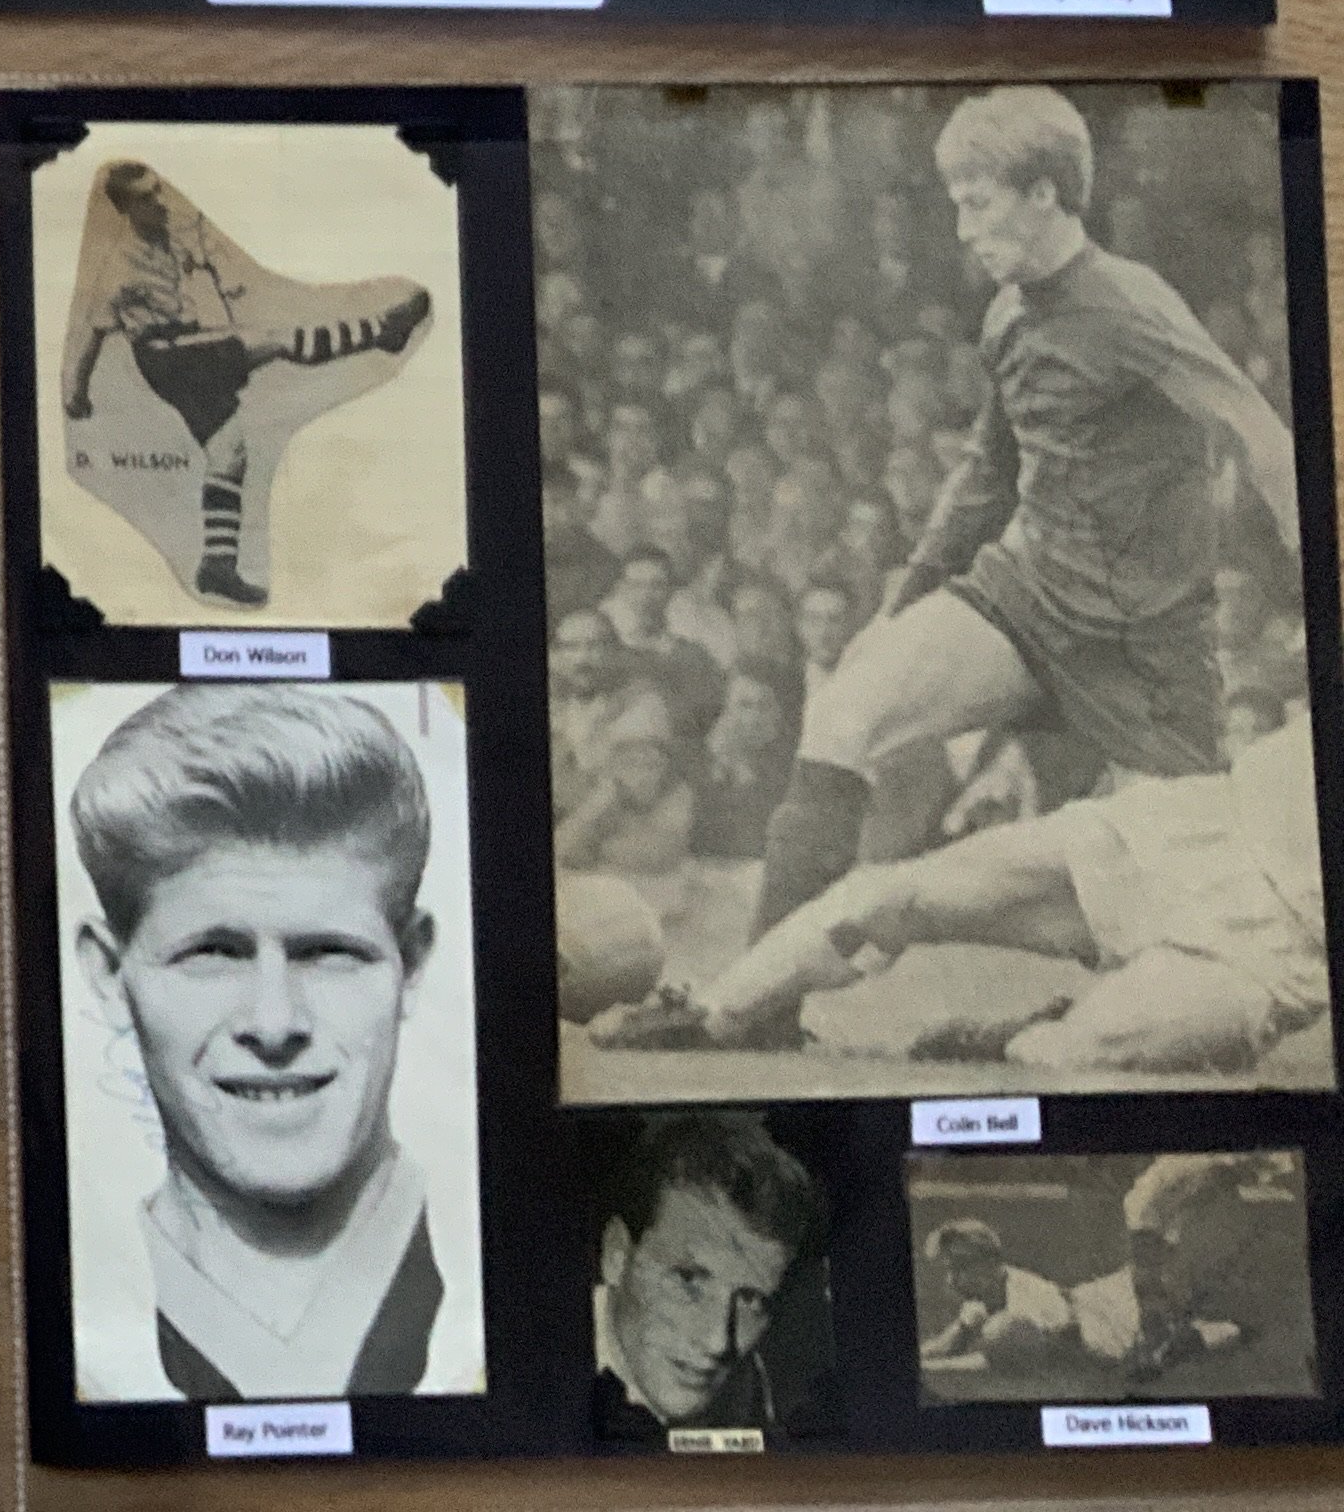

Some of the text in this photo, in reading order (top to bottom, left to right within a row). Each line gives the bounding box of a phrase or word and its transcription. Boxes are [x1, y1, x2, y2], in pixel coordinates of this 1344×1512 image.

[112, 452, 189, 471] WILSON
[203, 646, 307, 664] Don Wilson
[936, 1113, 1019, 1134] Colin Bell
[222, 1422, 255, 1444] Ray
[1065, 1412, 1189, 1433] Dave Hickson
